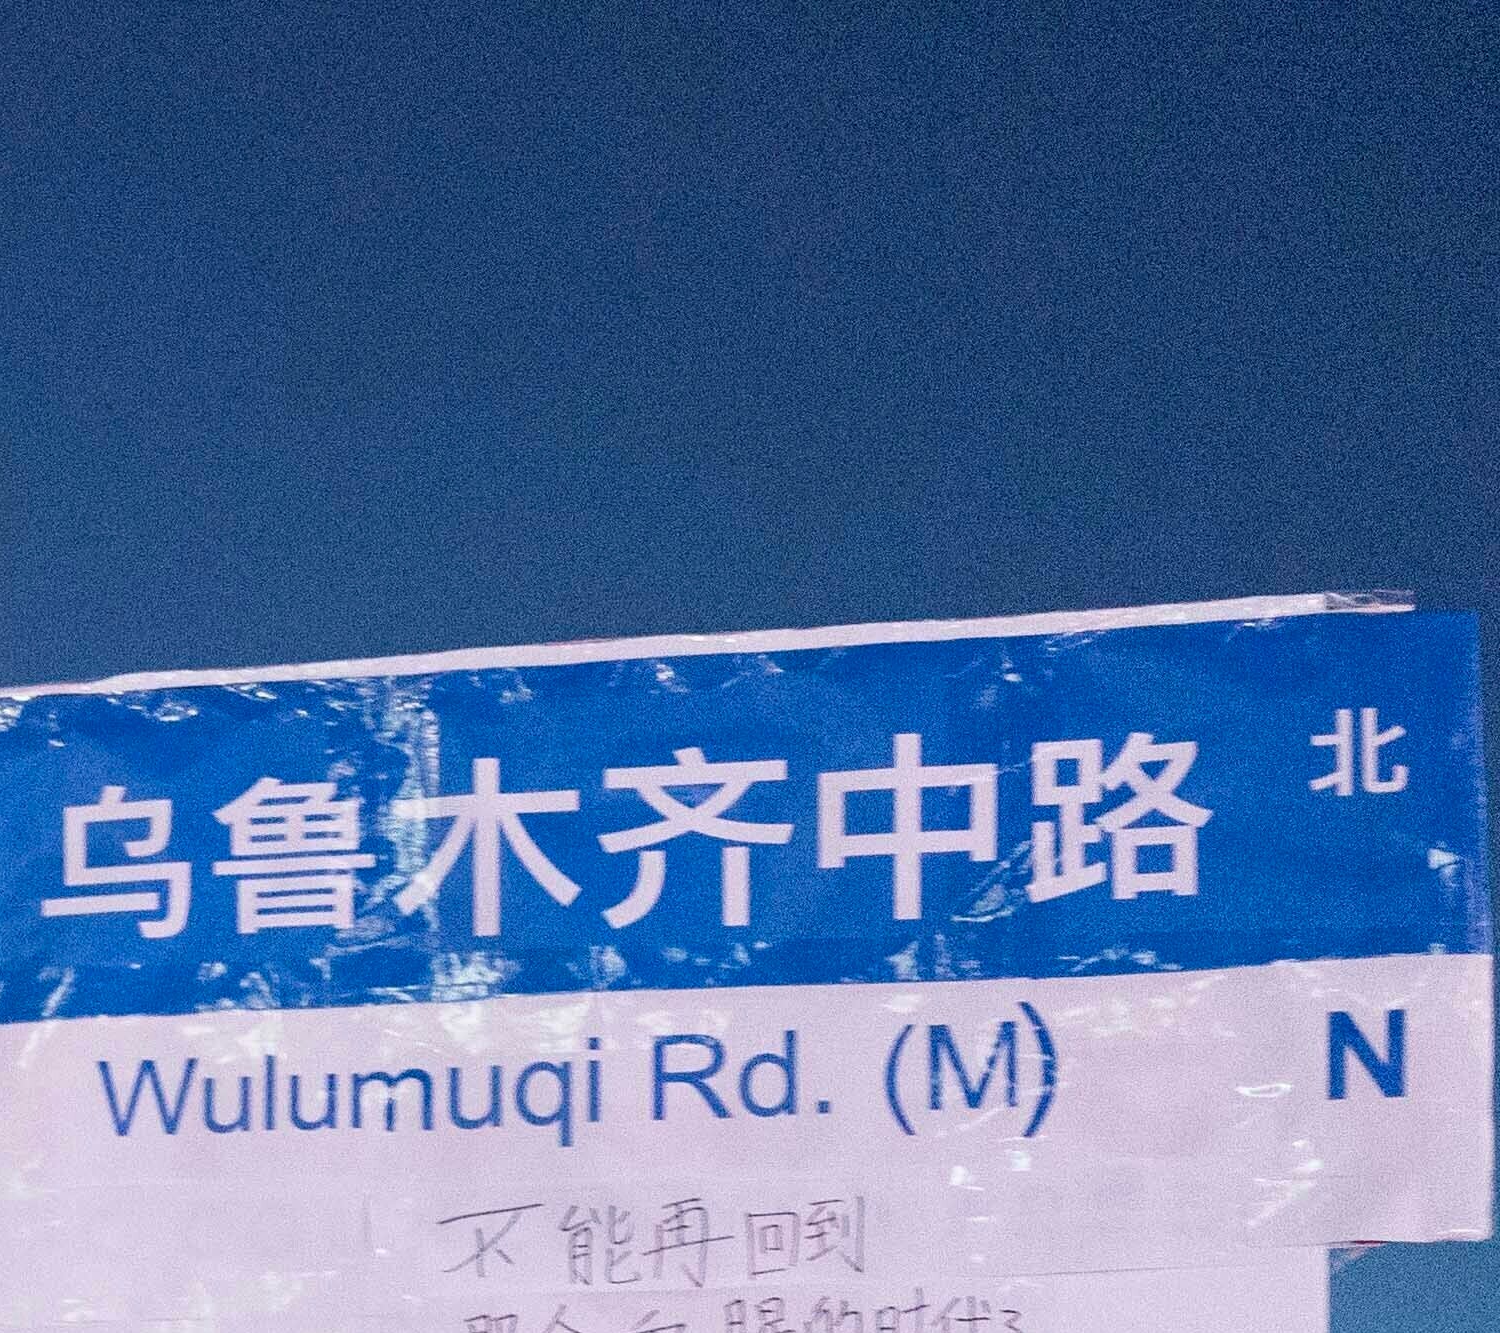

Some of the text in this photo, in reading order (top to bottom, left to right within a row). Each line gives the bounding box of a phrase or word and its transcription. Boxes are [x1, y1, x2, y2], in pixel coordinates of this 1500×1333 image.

[40, 730, 1214, 943] 乌鲁木齐中路
[1306, 705, 1410, 801] 北
[96, 1037, 602, 1148] Wulumuqi
[650, 1028, 835, 1123] Rd.
[881, 999, 1060, 1138] (M)
[1322, 1008, 1411, 1103] N
[434, 1196, 866, 1288] 不能再回到
